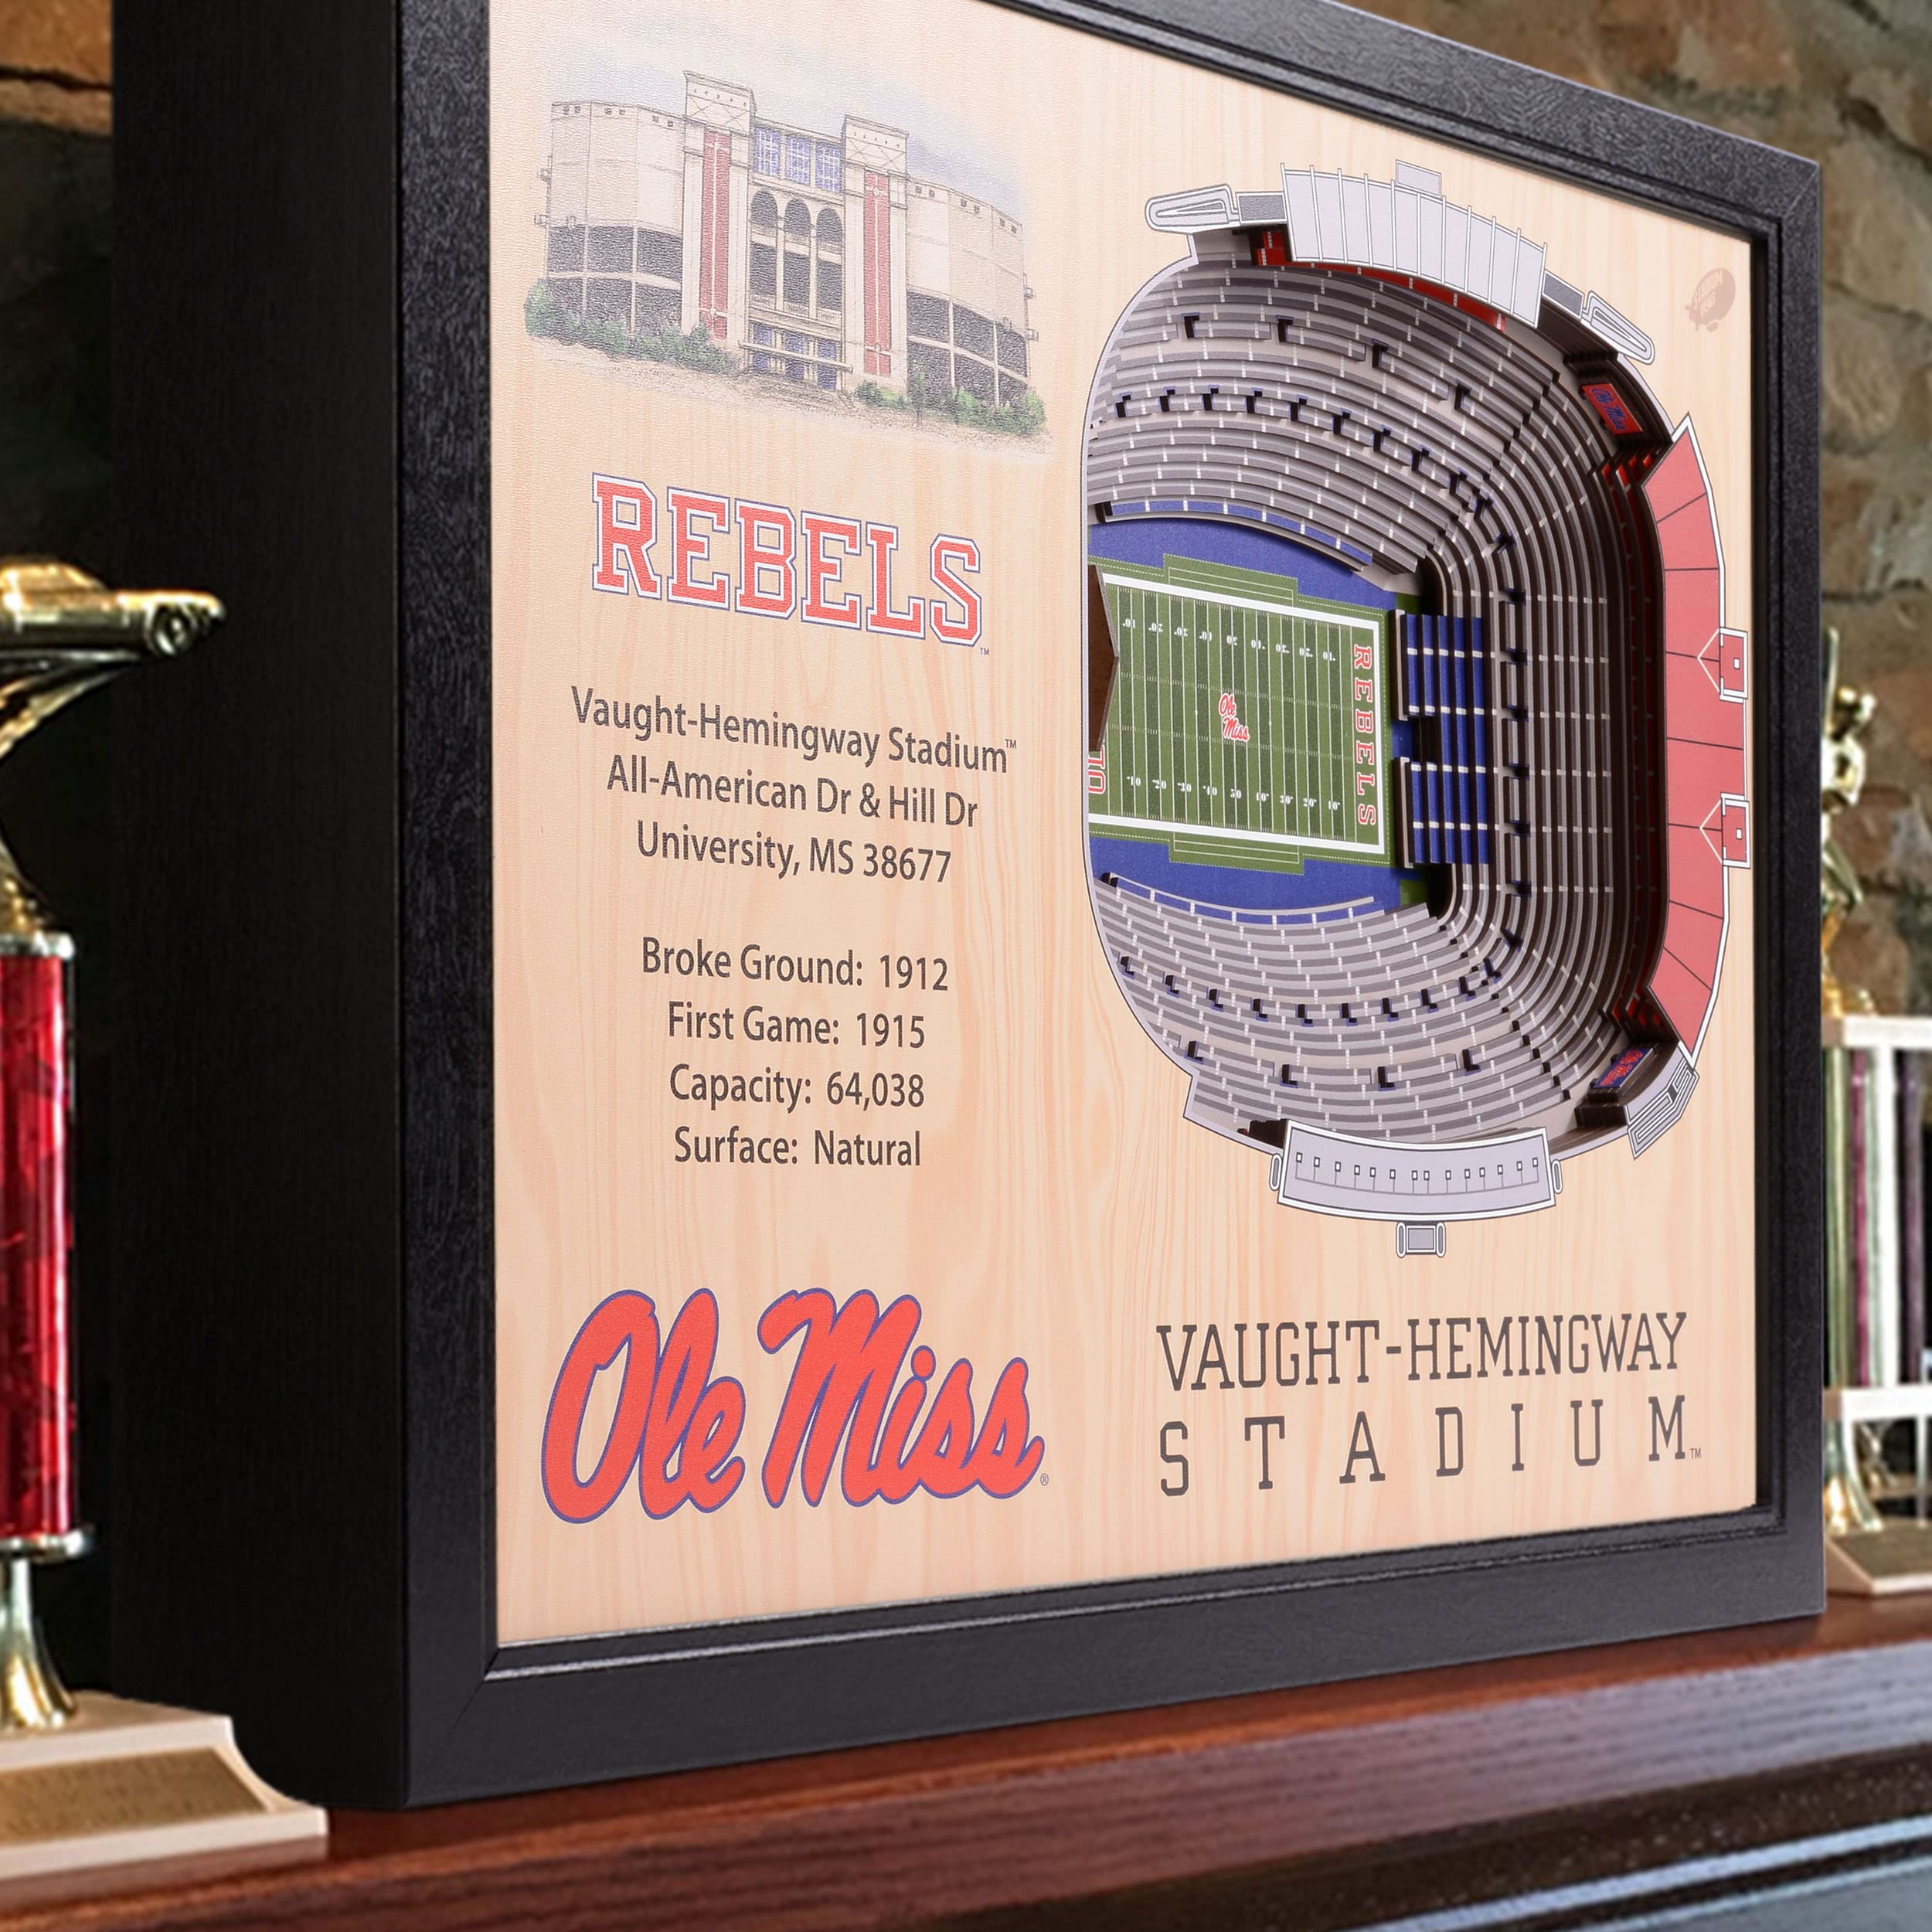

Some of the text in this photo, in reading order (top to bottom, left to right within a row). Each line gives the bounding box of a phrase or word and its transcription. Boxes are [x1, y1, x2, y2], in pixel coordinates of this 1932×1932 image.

[592, 472, 982, 647] REBELS
[570, 685, 879, 768] Vaught-Hemingway
[1219, 693, 1236, 716] Ole
[1223, 716, 1250, 742] Miss
[1355, 645, 1376, 825] REBELS
[607, 754, 978, 828] All-American Dr & Hill Dr
[638, 819, 951, 883] University, MS 38677
[642, 936, 948, 992] Broke Ground: 1912
[668, 1001, 925, 1049] First Game: 1915
[669, 1063, 924, 1114] Capacity: 64,038
[675, 1124, 920, 1166] Surface: Natural
[1155, 1311, 1687, 1392] VAUGHT-HEMINGWAY
[542, 1287, 746, 1524] Ole
[757, 1287, 1045, 1509] Miss
[1159, 1395, 1685, 1497] STADIUM
